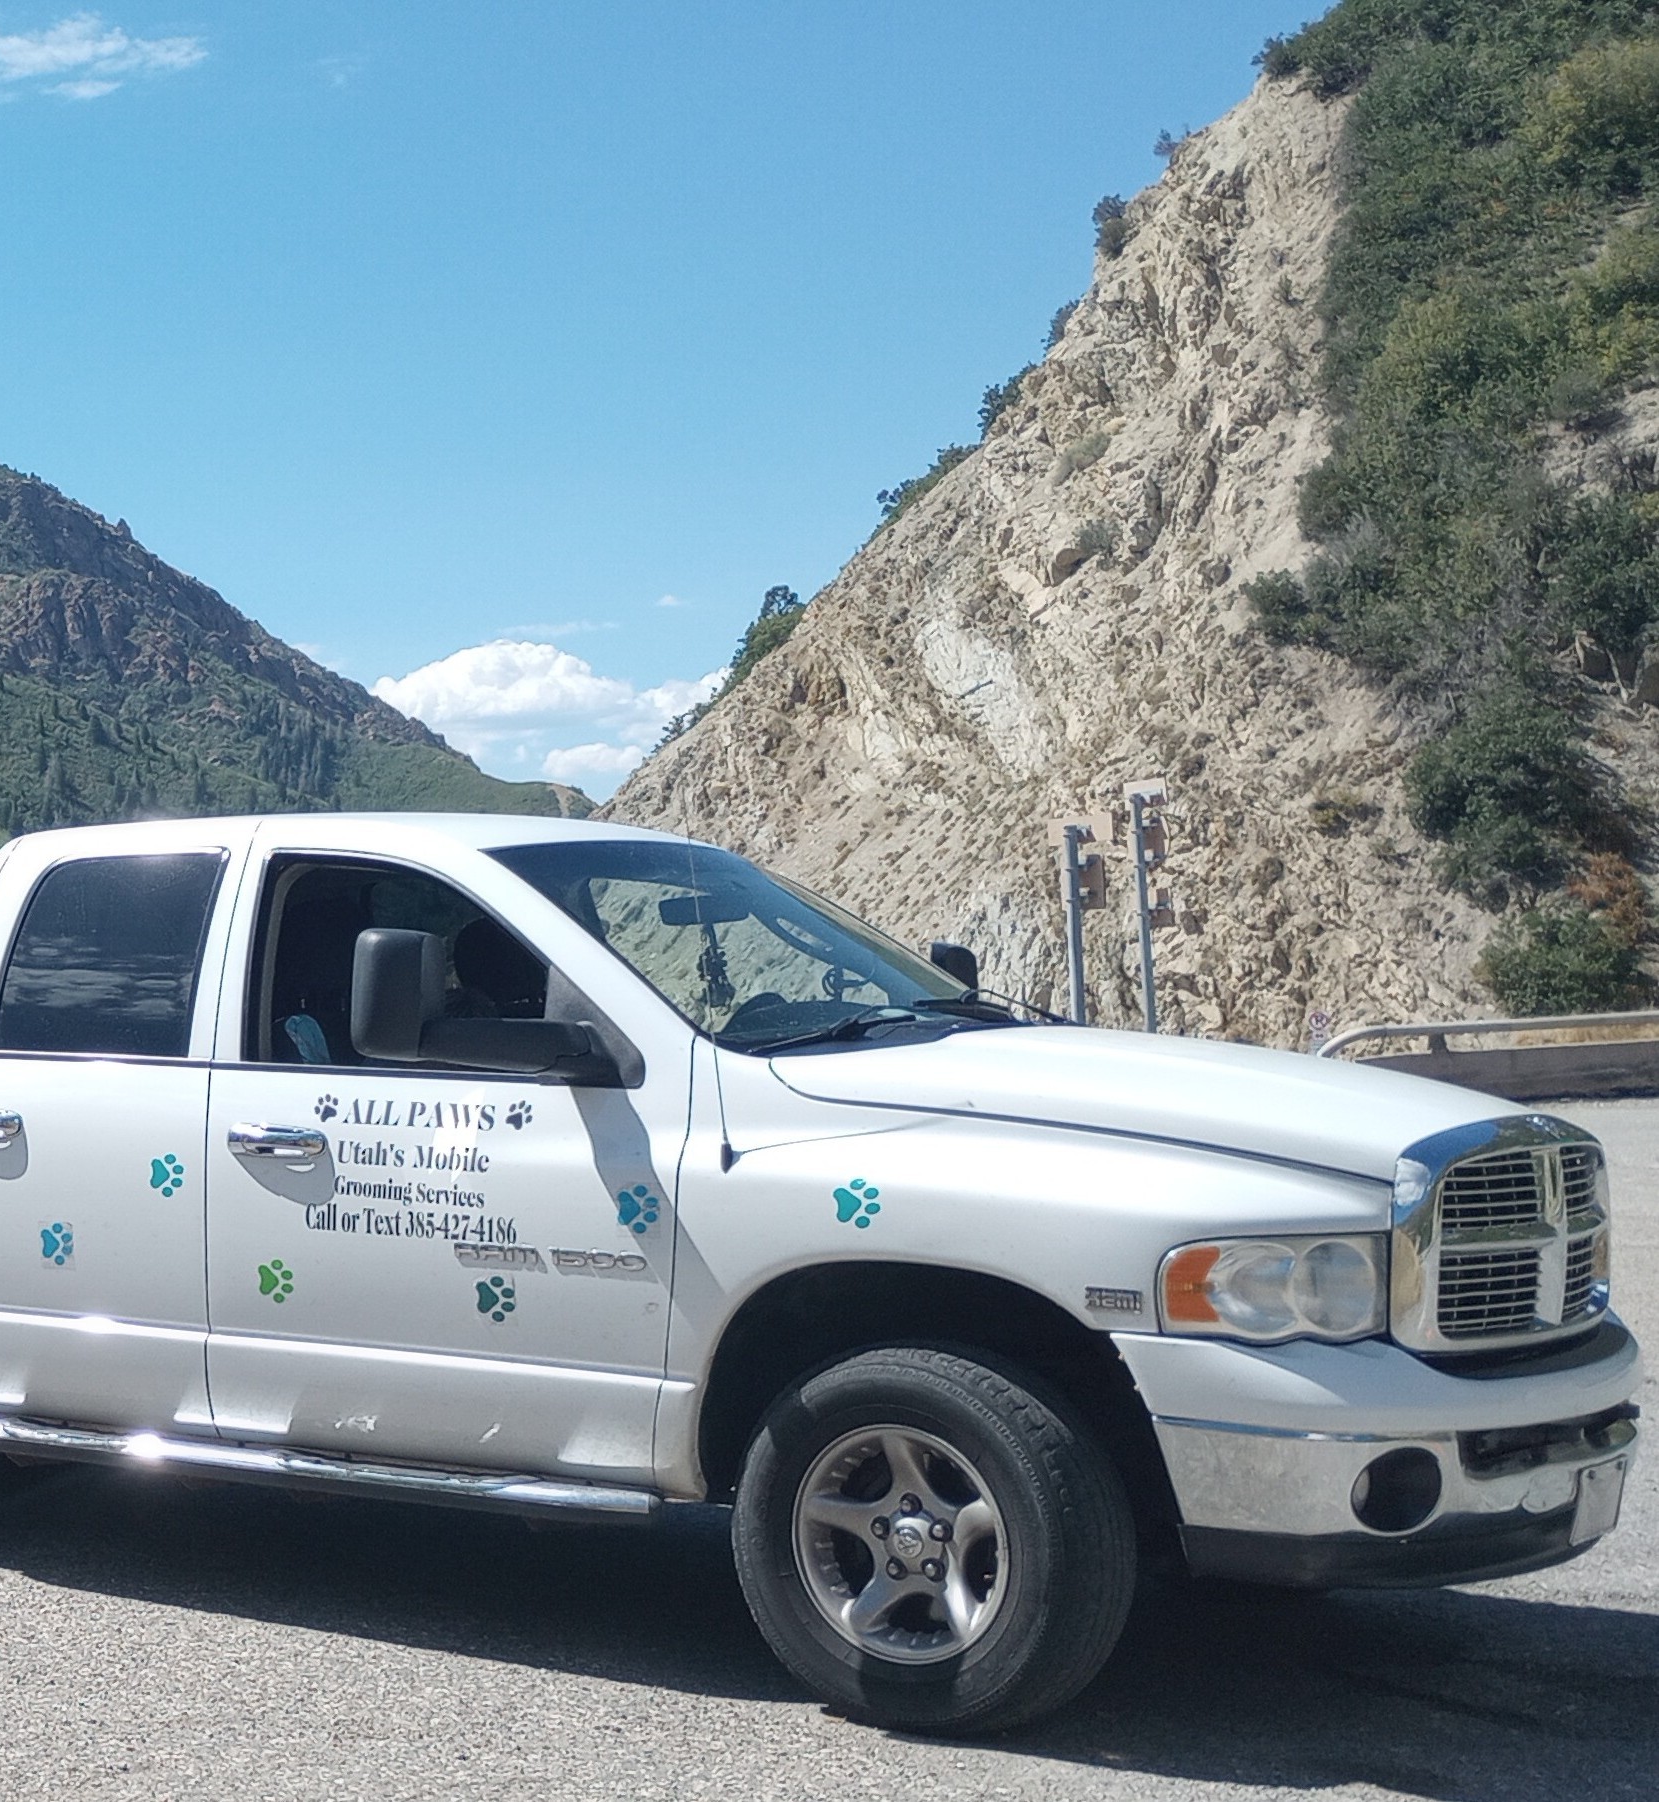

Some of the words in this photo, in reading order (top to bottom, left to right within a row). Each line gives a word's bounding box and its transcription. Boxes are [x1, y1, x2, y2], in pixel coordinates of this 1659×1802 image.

[342, 1098, 402, 1127] ALL
[406, 1101, 496, 1131] PAWS
[337, 1140, 406, 1168] Utah's
[413, 1144, 490, 1173] Mobile
[334, 1175, 412, 1207] Grooming
[416, 1182, 486, 1208] Services
[305, 1203, 337, 1231] Call
[341, 1212, 360, 1232] or
[362, 1208, 402, 1238] Text
[405, 1210, 517, 1243] 385-427-4186
[548, 1246, 647, 1272] 1500
